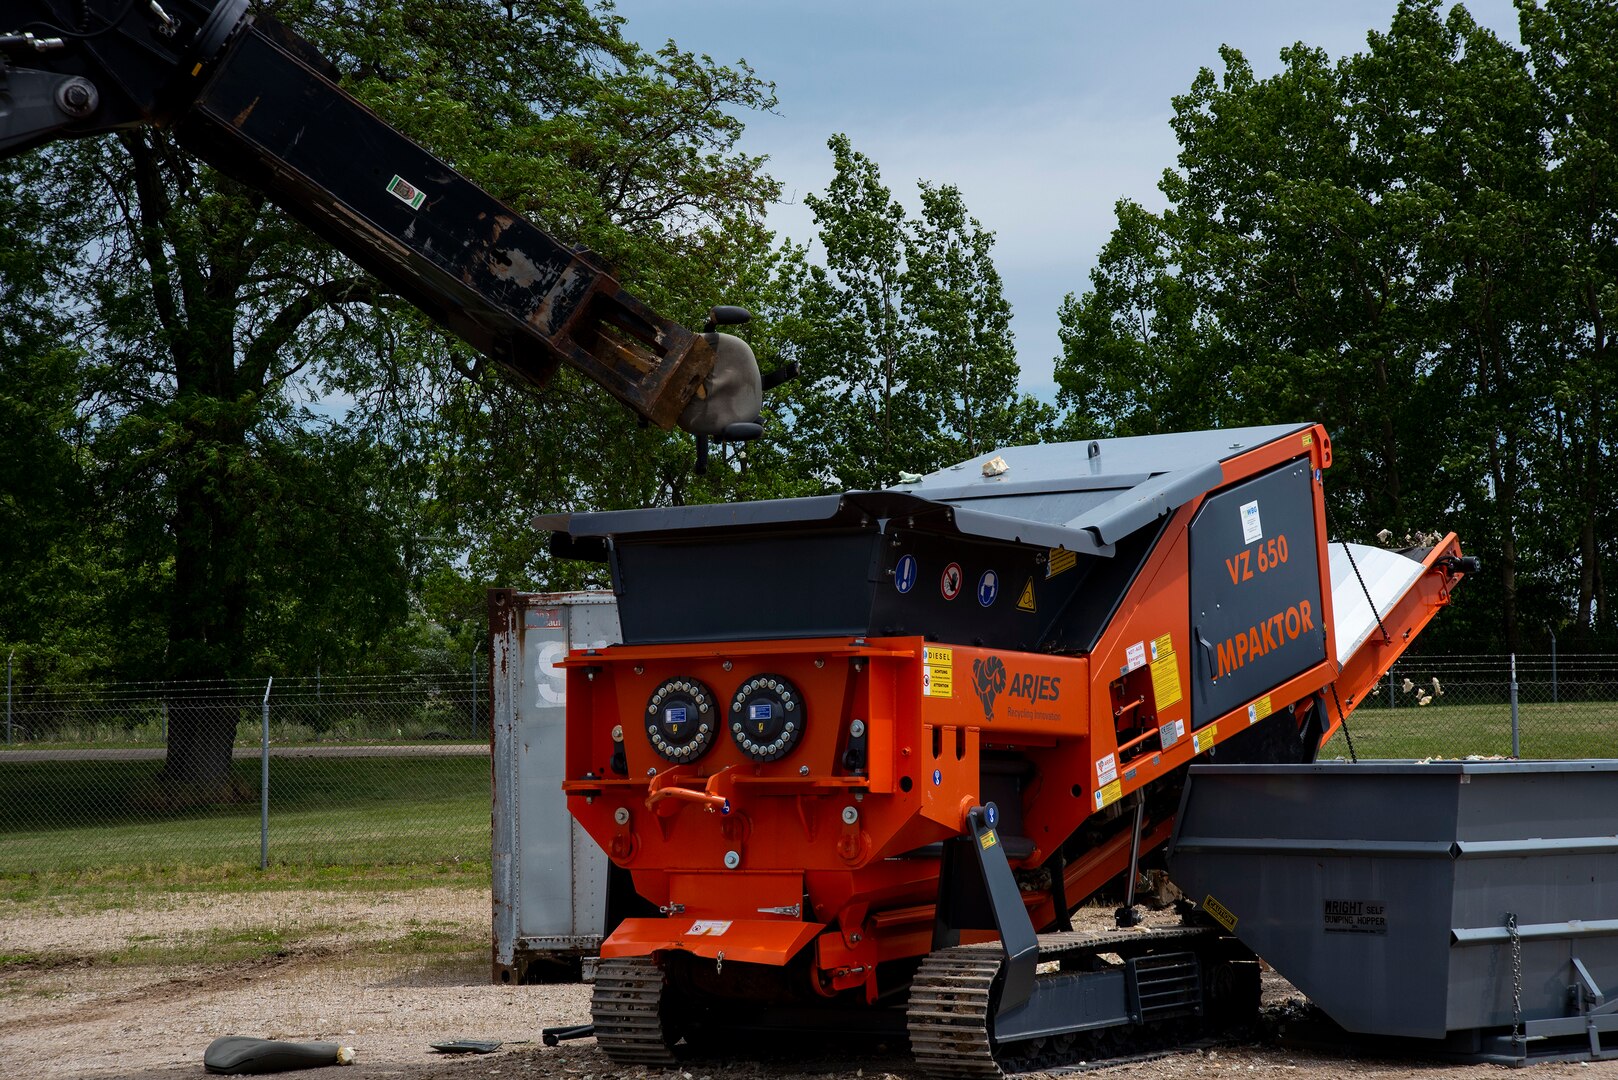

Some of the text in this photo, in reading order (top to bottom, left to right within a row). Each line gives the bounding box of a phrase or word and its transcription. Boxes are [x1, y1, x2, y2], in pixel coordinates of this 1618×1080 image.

[1225, 534, 1289, 585] VZ 650
[1211, 599, 1314, 681] MPAKTOR
[928, 651, 950, 661] DIESEL
[1008, 672, 1061, 705] ARJES
[1007, 706, 1033, 721] Recycling
[1208, 899, 1234, 924] CAUTION
[1325, 900, 1385, 915] WRIGHT SELF
[1325, 915, 1385, 926] DUMPING HOPPER
